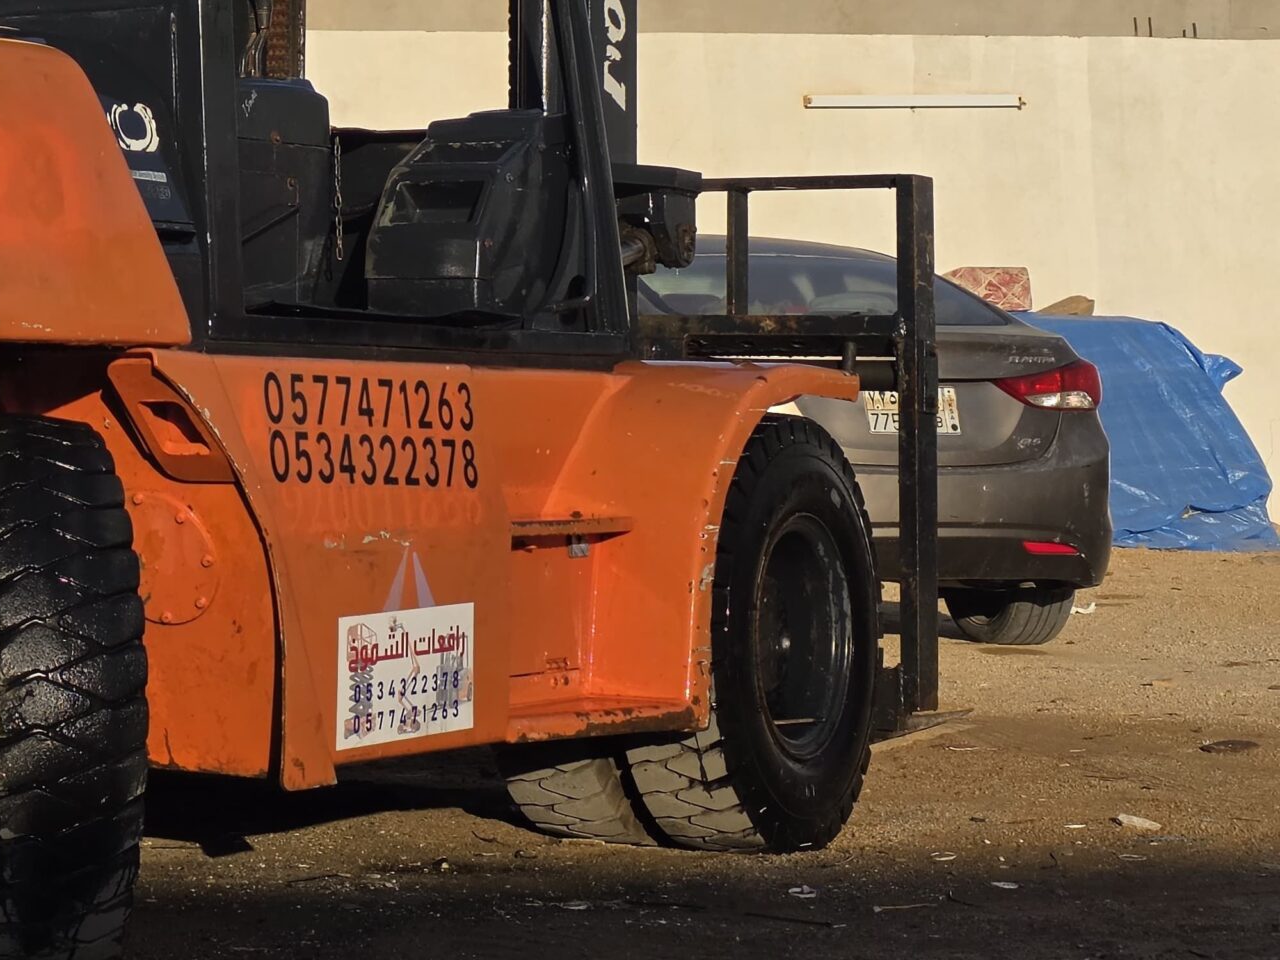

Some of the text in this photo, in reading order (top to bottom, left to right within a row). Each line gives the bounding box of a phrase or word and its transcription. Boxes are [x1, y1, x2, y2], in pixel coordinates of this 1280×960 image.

[264, 371, 474, 431] 0577471263
[269, 429, 479, 489] 0534322378
[348, 624, 466, 673] رافعات الشموخ
[353, 670, 460, 704] 0534322378
[352, 699, 460, 735] 0577471263
